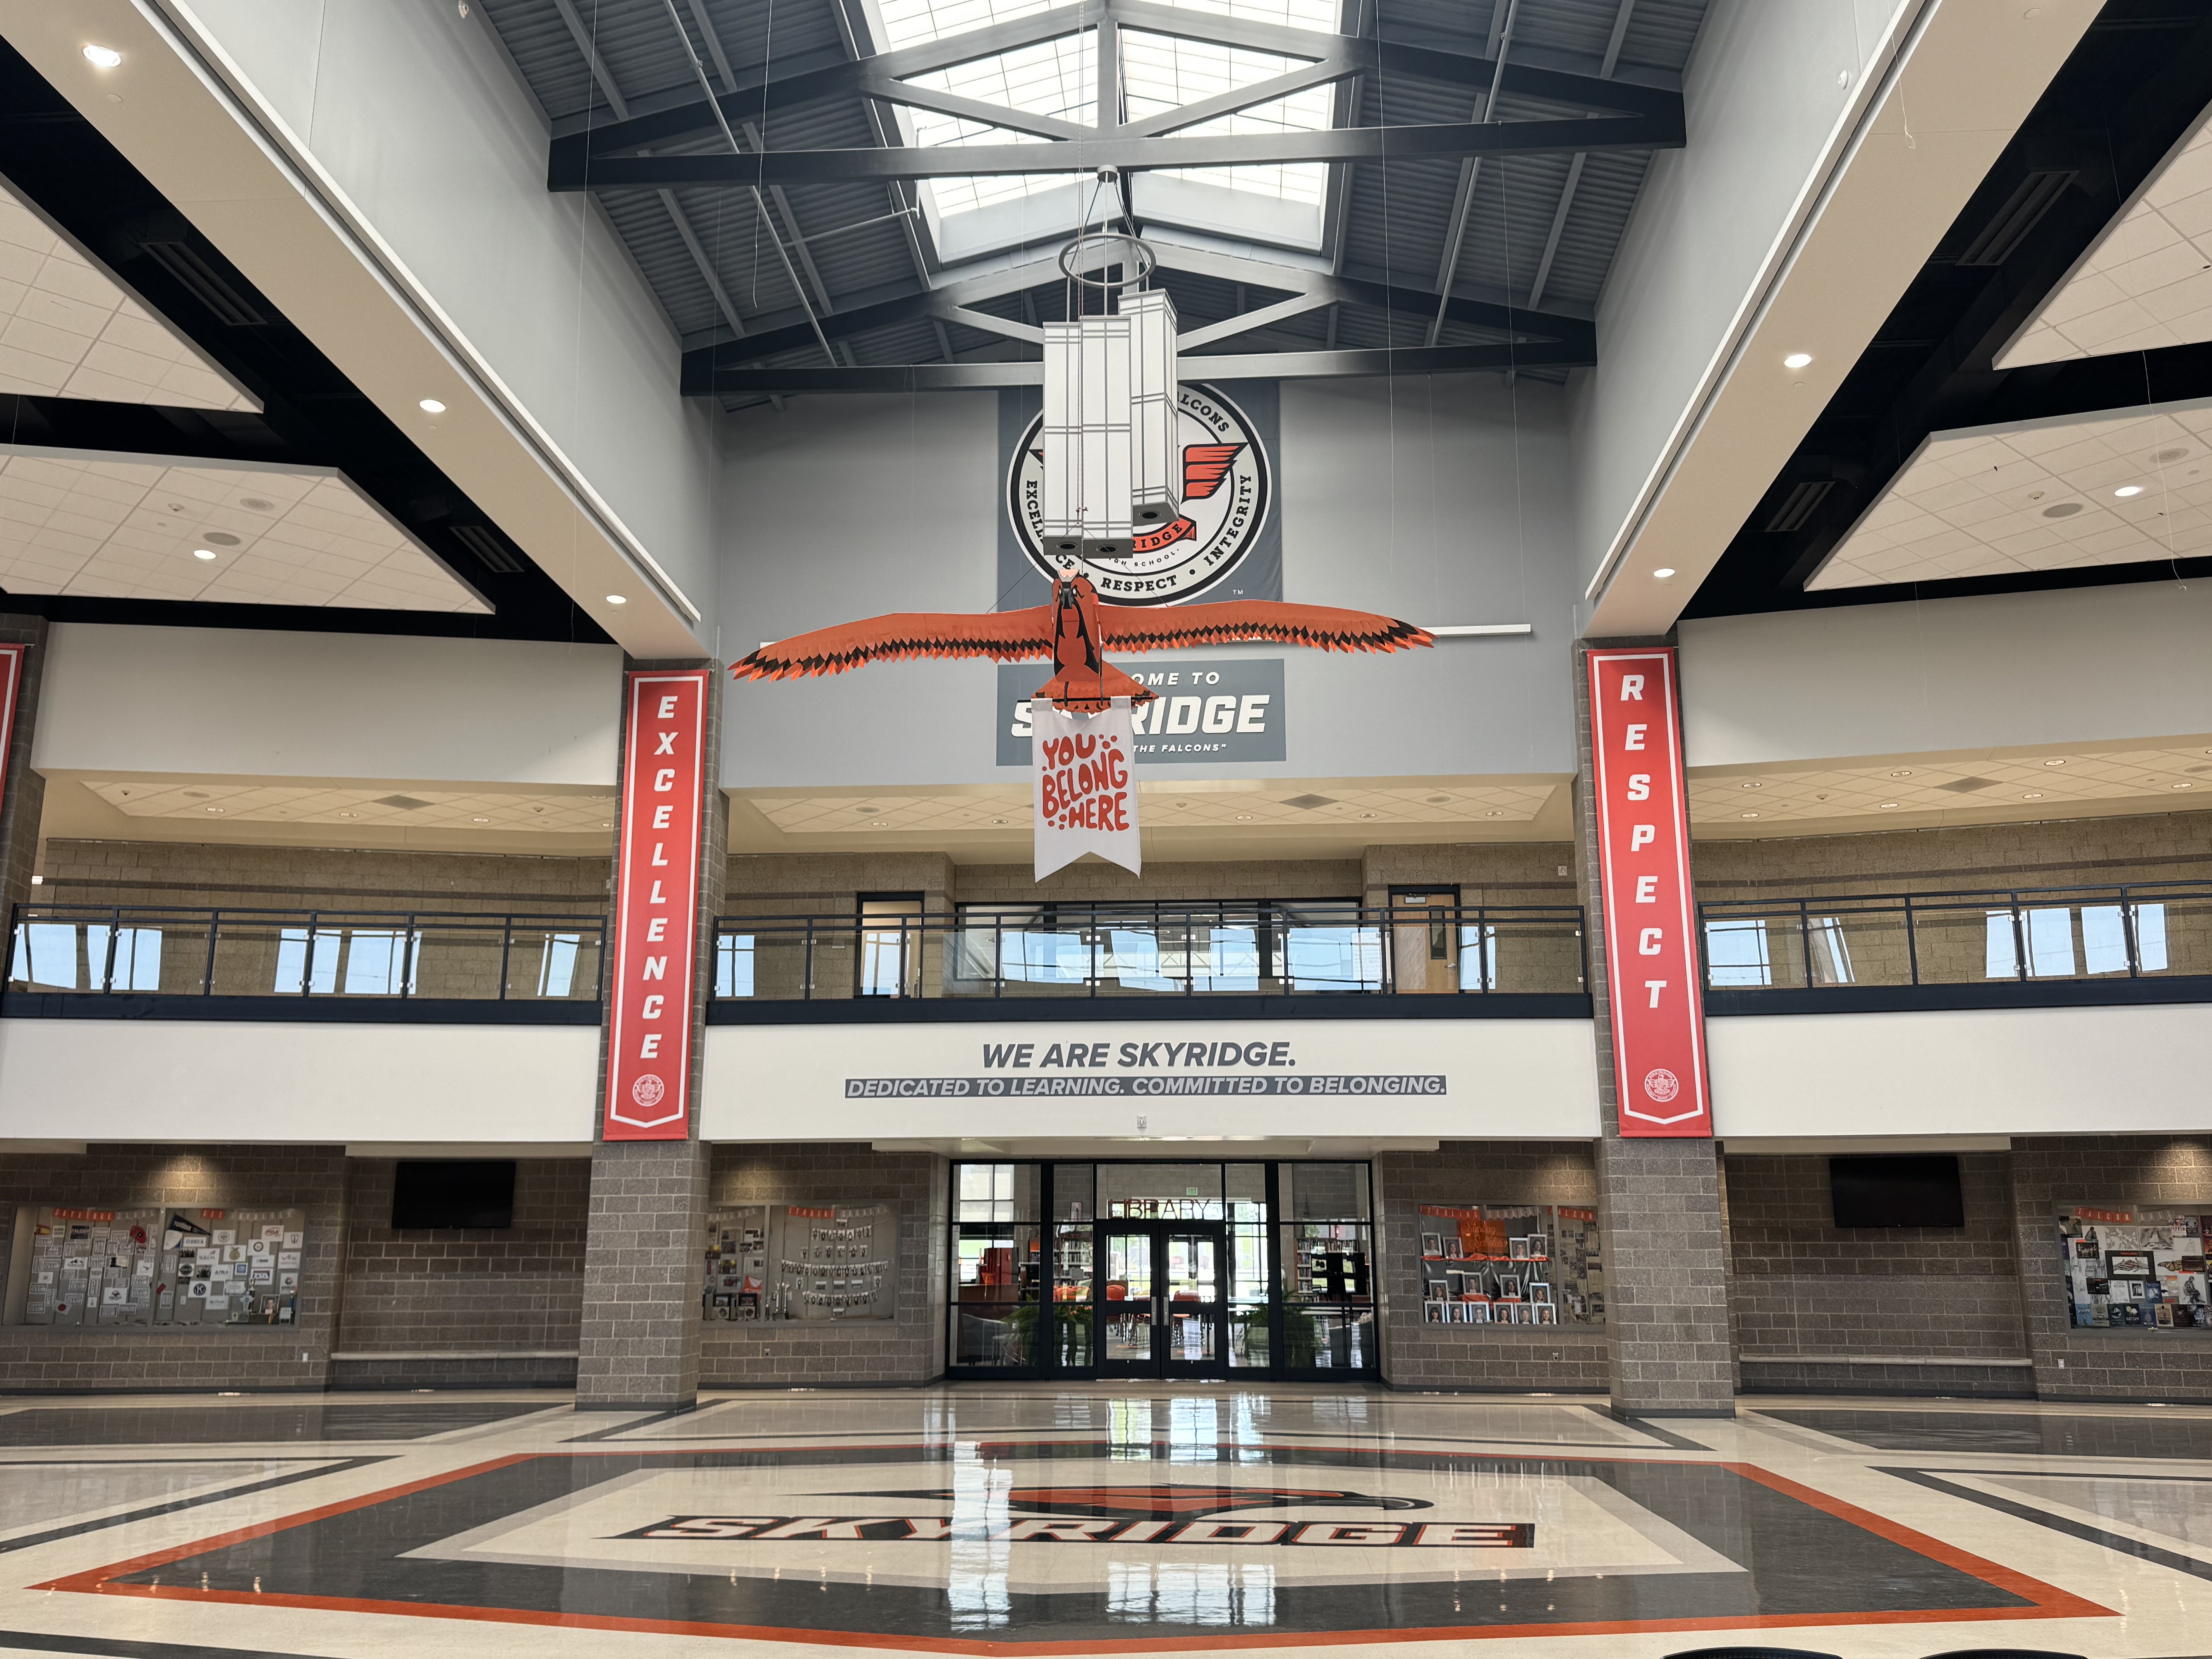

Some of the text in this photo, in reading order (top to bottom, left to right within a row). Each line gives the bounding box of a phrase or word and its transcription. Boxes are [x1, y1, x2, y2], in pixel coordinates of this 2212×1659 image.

[1178, 391, 1229, 432] LCONS
[1101, 575, 1176, 592] RESPECT
[1204, 475, 1251, 566] INTEGRITY
[1134, 551, 1175, 567] SCHOOL
[1131, 672, 1219, 686] OME TO
[1042, 733, 1096, 770] YOU
[1042, 749, 1128, 818] BELONG
[1069, 792, 1130, 831] HERE
[1621, 675, 1667, 1008] RESPECT
[640, 696, 678, 1058] EXCELLENCE
[984, 1042, 1296, 1068] WE ARE SKYRIDGE.
[847, 1077, 1446, 1097] DEDICATED TO LEARNING. COMMITTED TO BELONGING.
[1108, 1199, 1211, 1219] LIBRARY
[1419, 1205, 1478, 1218] STERLING
[1558, 1208, 1592, 1219] ALCON
[2078, 1208, 2129, 1221] FALCON
[635, 1516, 1520, 1546] SKYRIDGE
